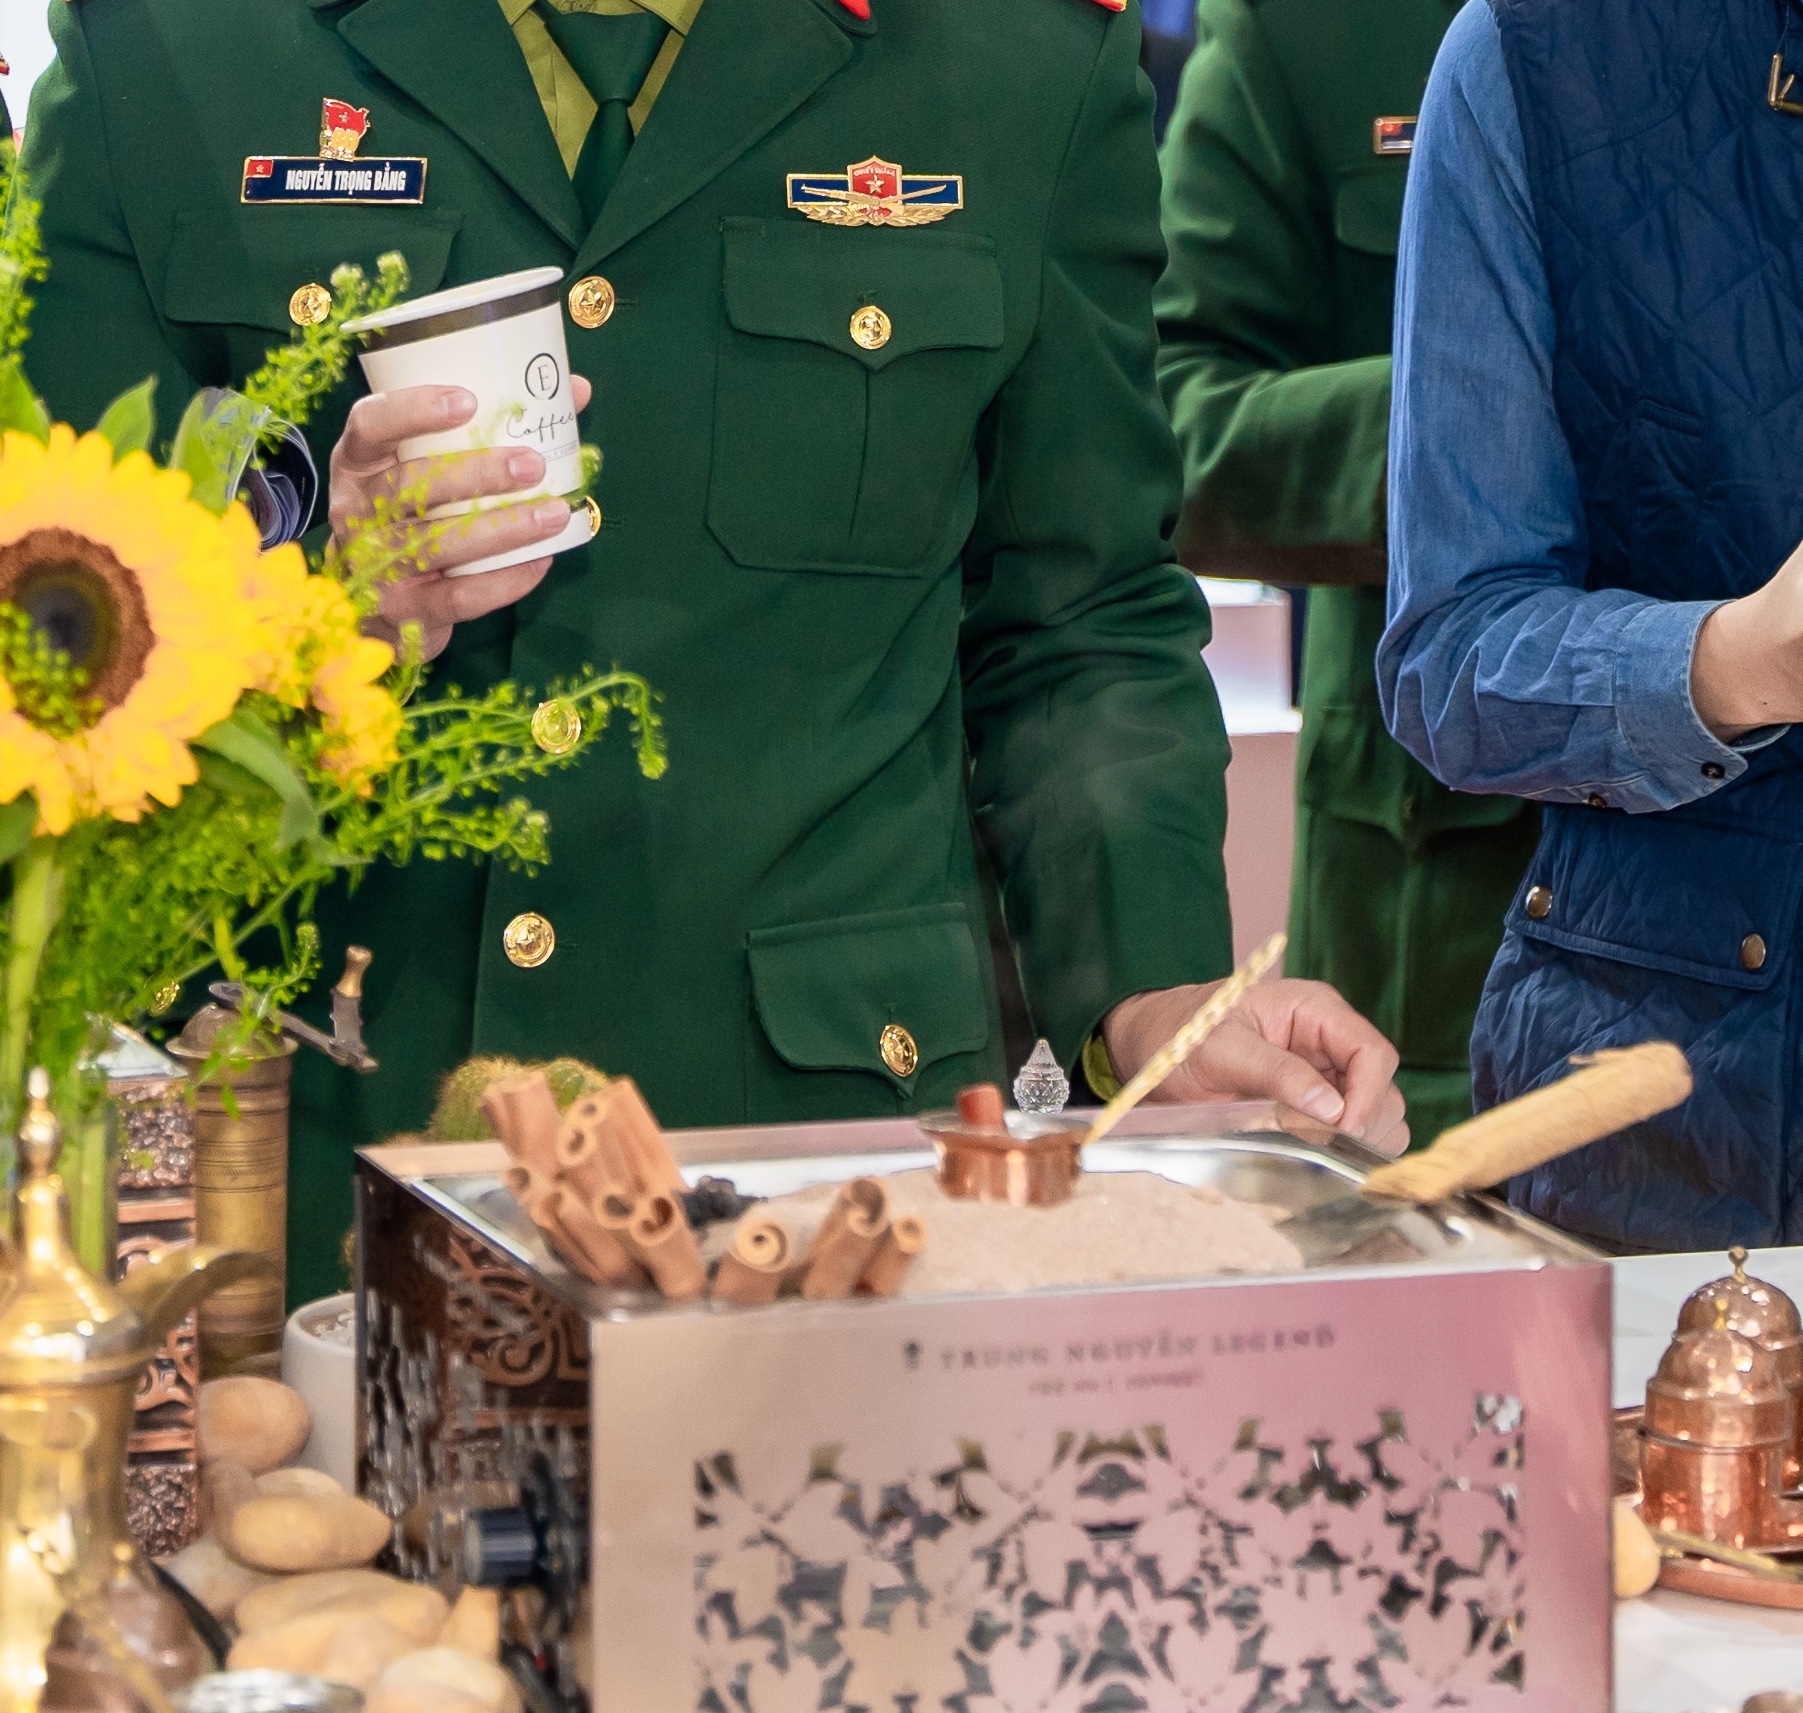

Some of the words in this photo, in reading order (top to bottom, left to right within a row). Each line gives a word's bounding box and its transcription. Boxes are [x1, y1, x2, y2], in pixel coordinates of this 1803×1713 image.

[285, 163, 333, 190] NGUYỄN
[334, 170, 373, 195] TRỌNG
[940, 1345, 1050, 1369] TRUNG
[1212, 1322, 1336, 1356] LEGEND
